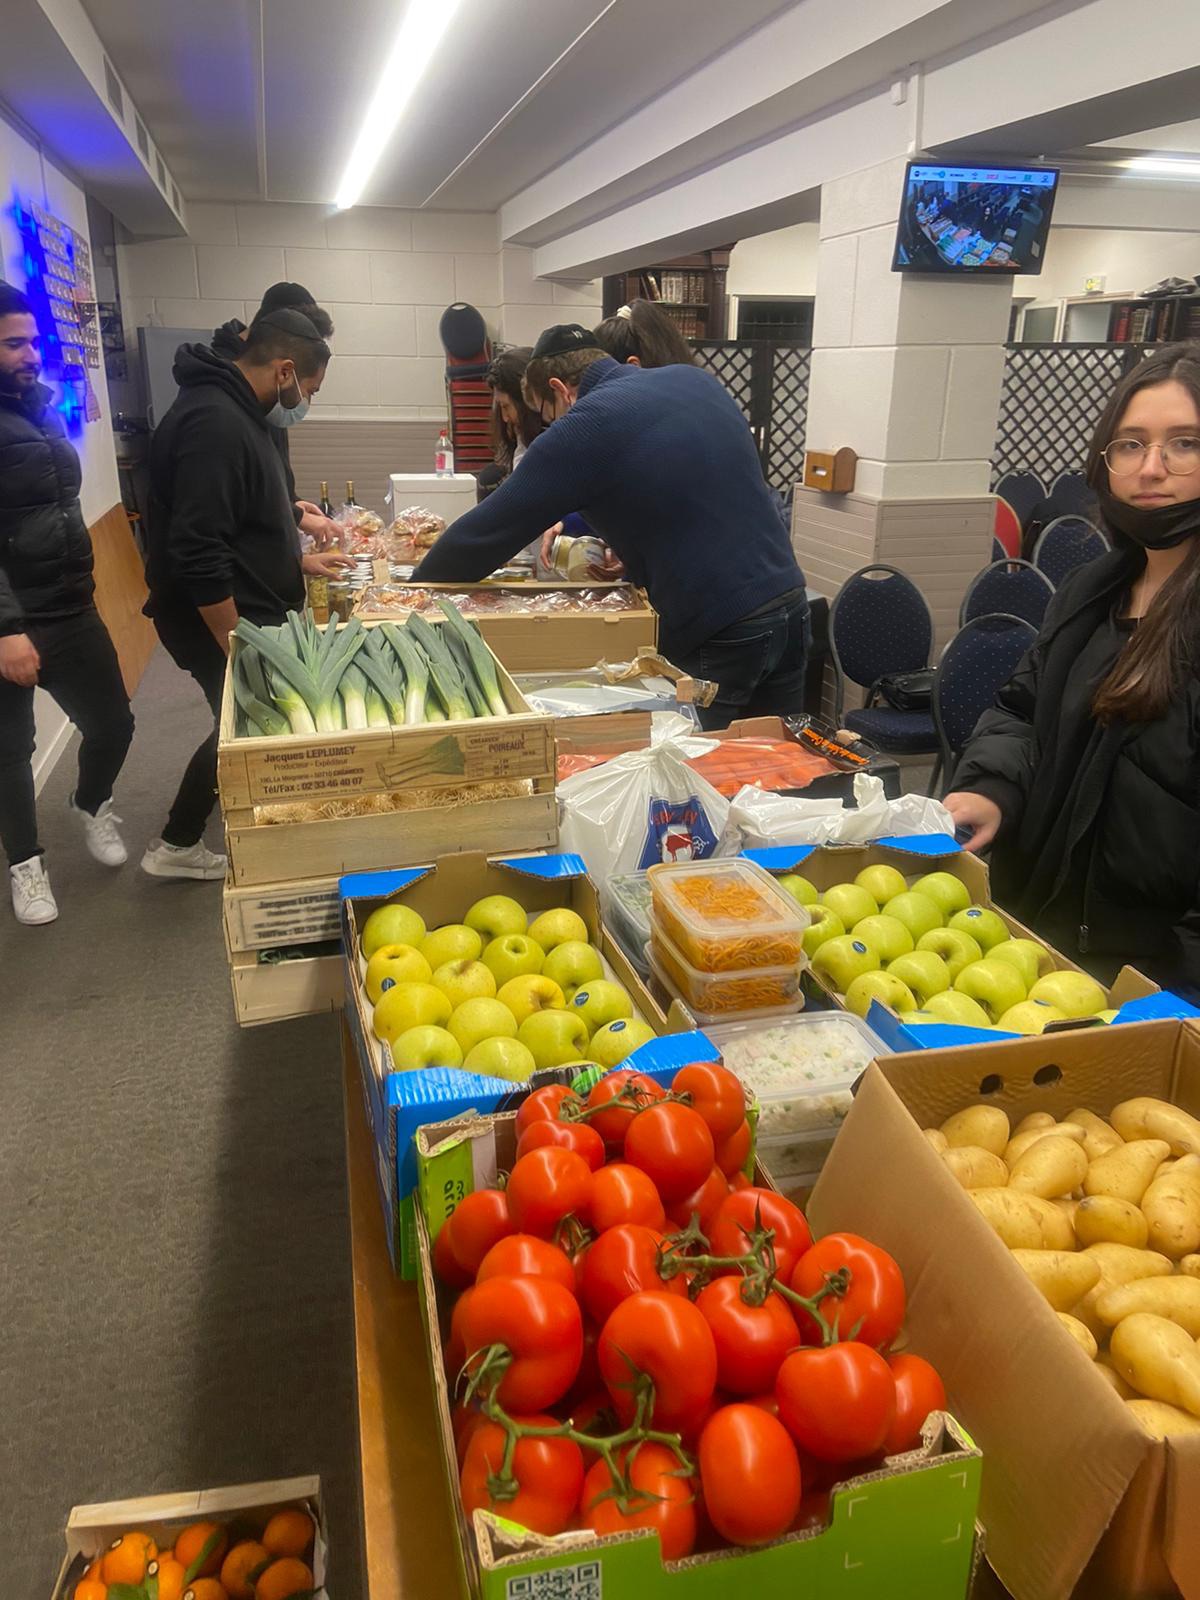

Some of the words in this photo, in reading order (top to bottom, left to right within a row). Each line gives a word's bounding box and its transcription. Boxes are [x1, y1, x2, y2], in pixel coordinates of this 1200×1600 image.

[264, 752, 304, 763] Jacques
[306, 746, 356, 759] LEPLUMEY
[488, 739, 525, 753] POIREAUX
[264, 784, 294, 795] Tél/Fax
[302, 782, 313, 791] 02
[314, 780, 325, 790] 33
[352, 776, 363, 786] 07
